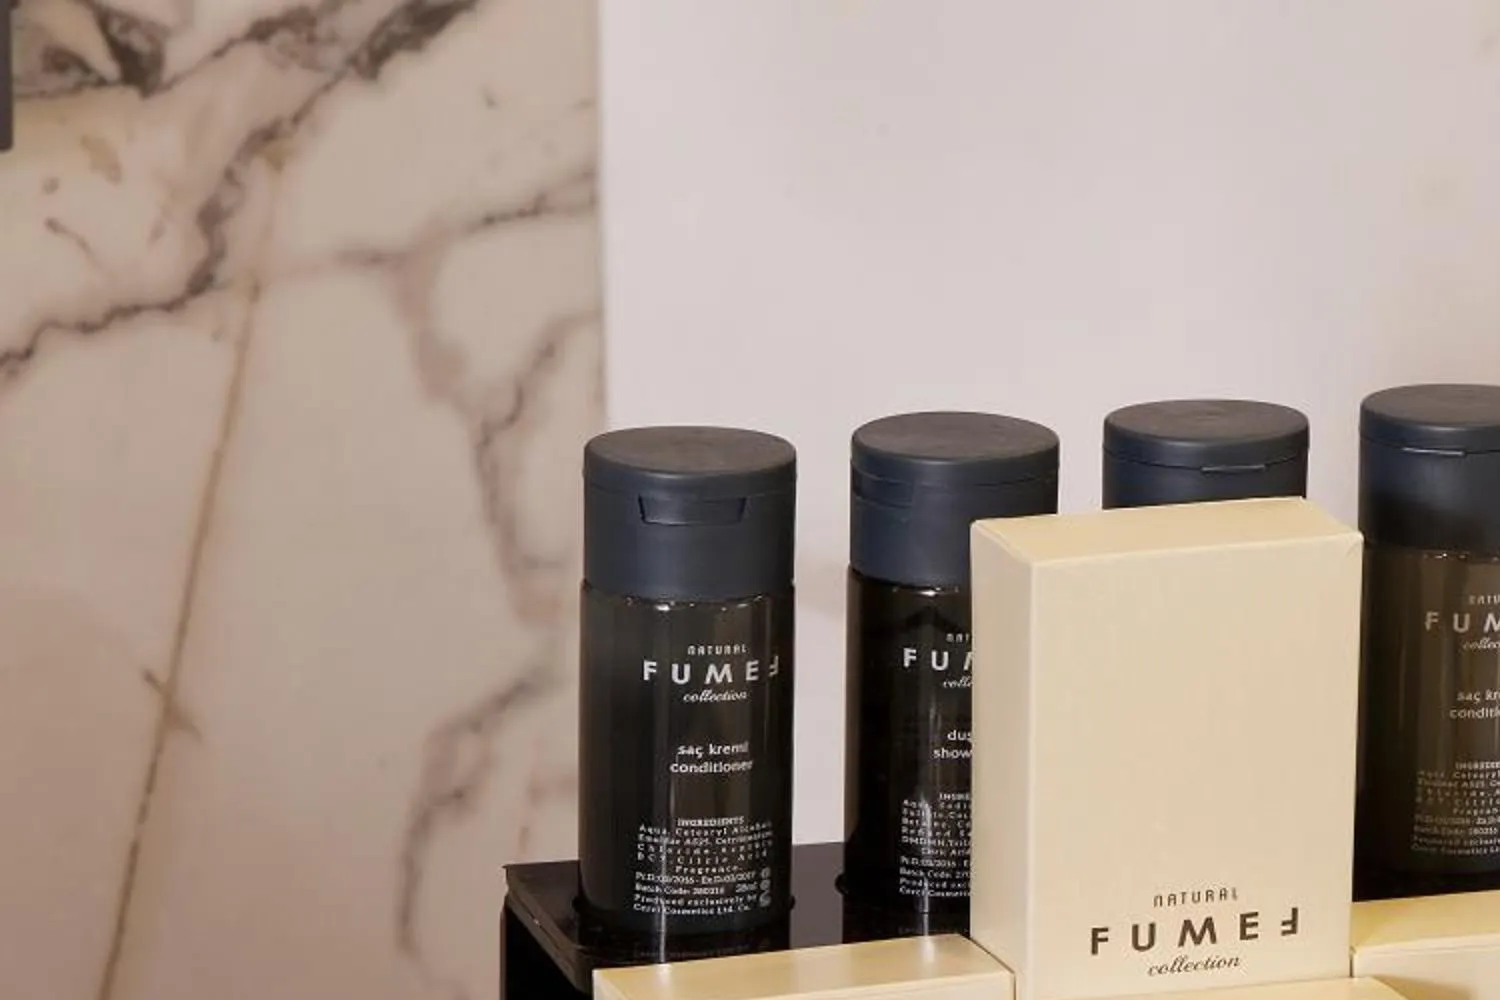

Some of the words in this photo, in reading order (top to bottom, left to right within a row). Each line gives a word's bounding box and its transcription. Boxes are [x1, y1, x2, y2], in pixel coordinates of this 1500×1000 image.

[683, 688, 748, 702] collection
[670, 760, 753, 773] conditioner
[1148, 954, 1241, 976] collection
